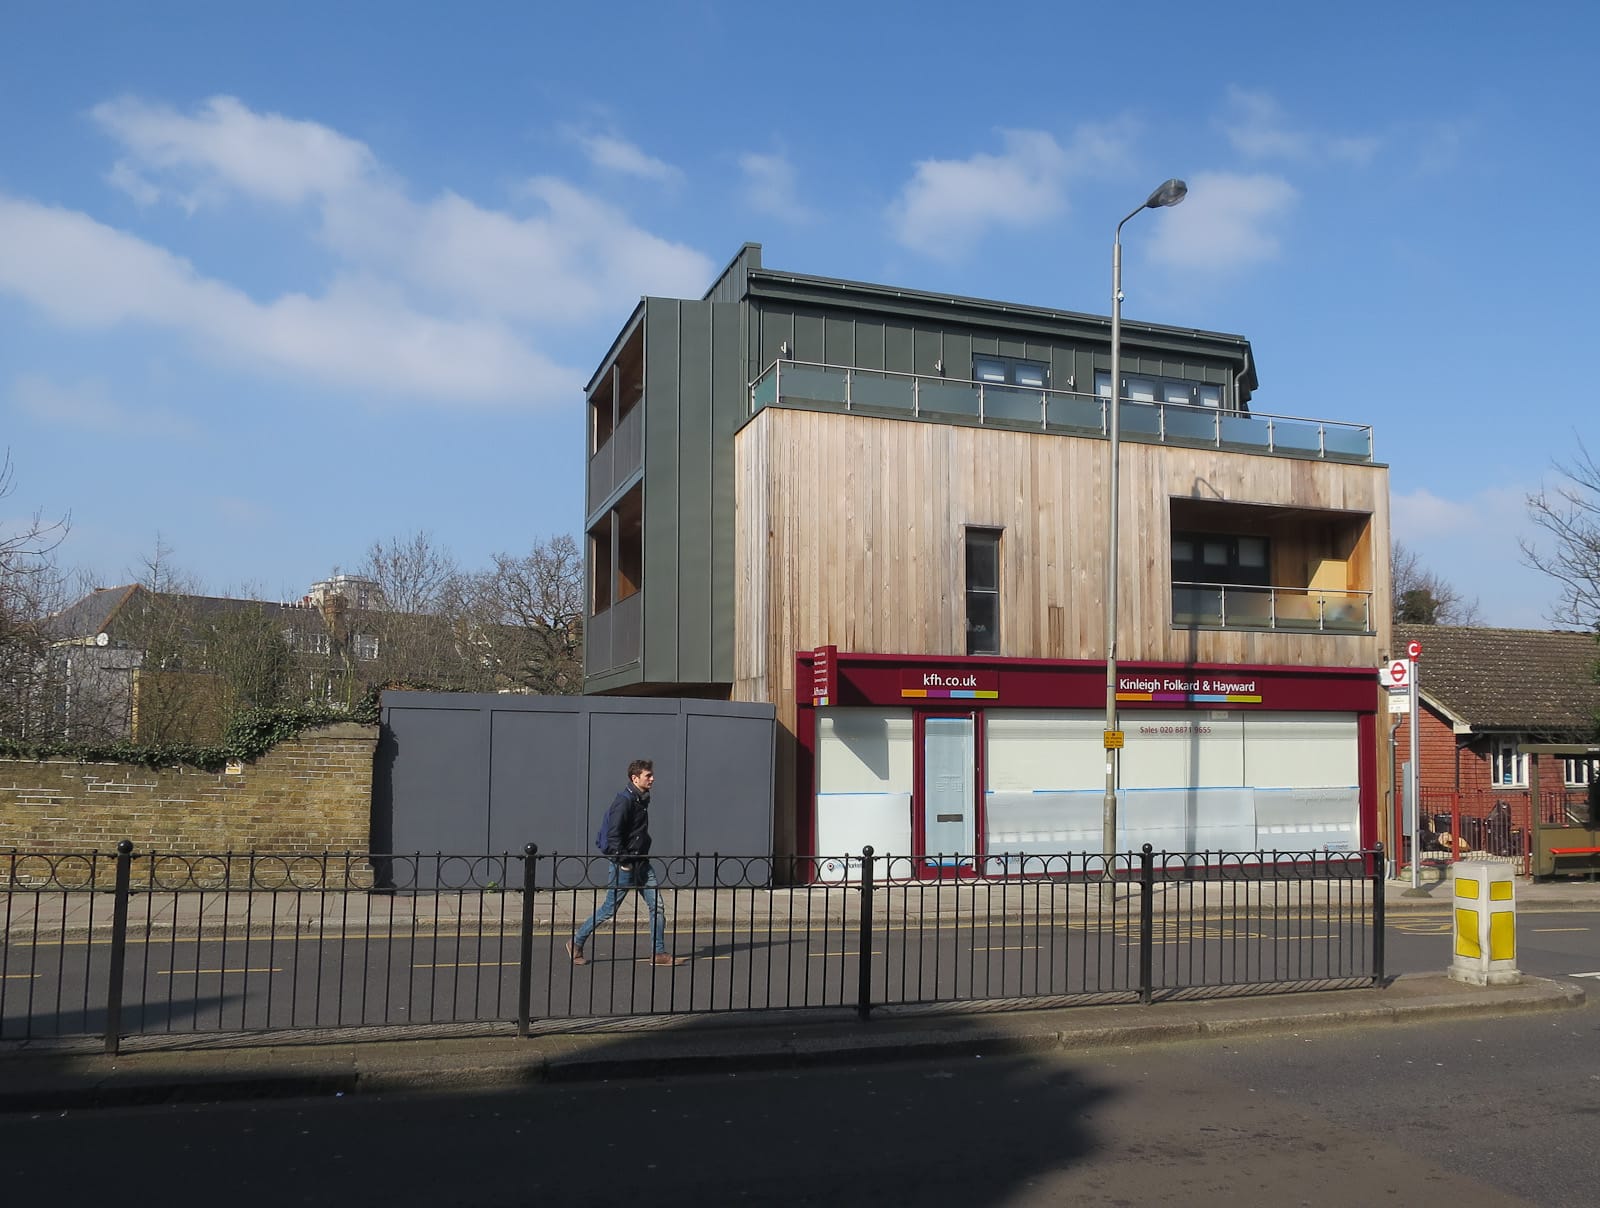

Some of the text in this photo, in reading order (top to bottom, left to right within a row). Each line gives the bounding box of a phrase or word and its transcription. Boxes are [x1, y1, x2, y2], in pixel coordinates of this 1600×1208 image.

[1409, 643, 1418, 656] C
[923, 673, 977, 687] kfh.co.uk
[1120, 678, 1255, 694] Kinleigh Folkard & Hayward
[1140, 726, 1158, 734] Sales
[1160, 726, 1174, 734] 020
[1175, 726, 1192, 734] 8871
